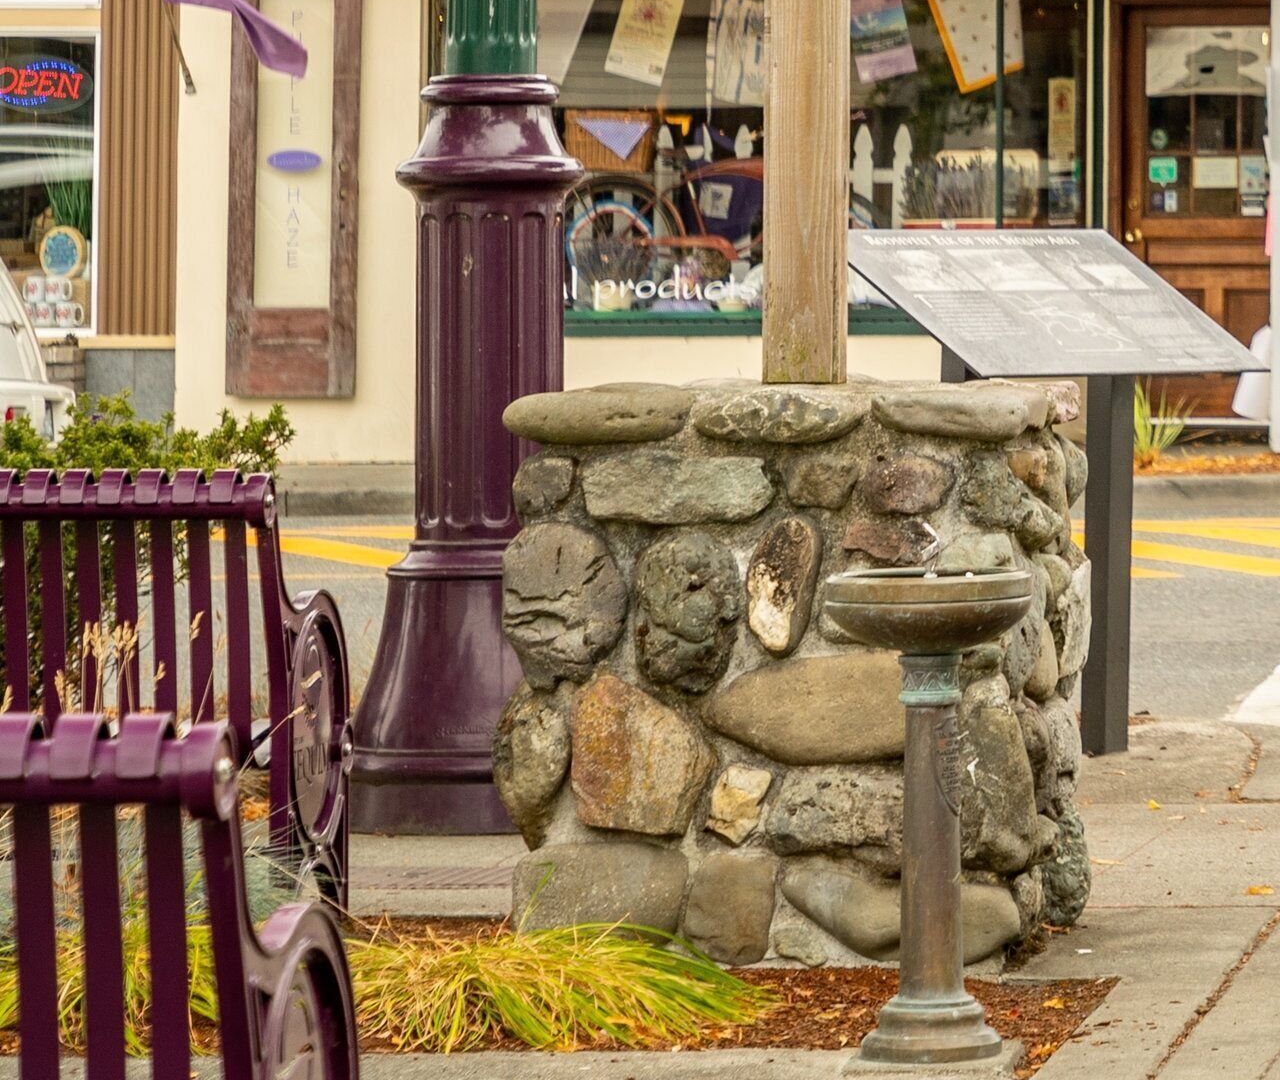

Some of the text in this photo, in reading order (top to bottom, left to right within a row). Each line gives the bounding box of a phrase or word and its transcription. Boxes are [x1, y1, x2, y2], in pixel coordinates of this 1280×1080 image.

[0, 65, 84, 100] OPEN
[286, 186, 301, 269] HAZE
[594, 264, 759, 311] products
